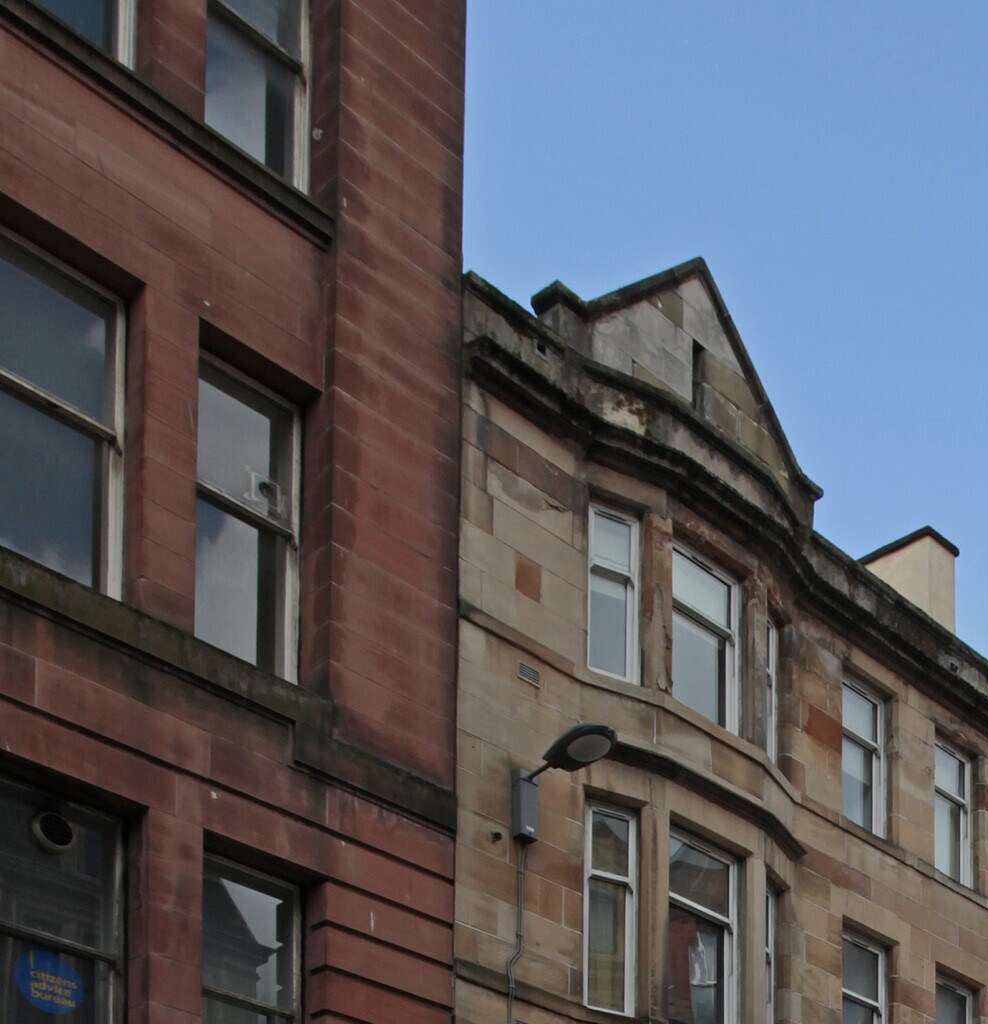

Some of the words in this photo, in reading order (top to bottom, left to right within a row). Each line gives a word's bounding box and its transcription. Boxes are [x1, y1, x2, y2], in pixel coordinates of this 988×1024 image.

[30, 970, 77, 989] citizens
[31, 981, 71, 996] advice
[31, 989, 76, 1007] bureau
